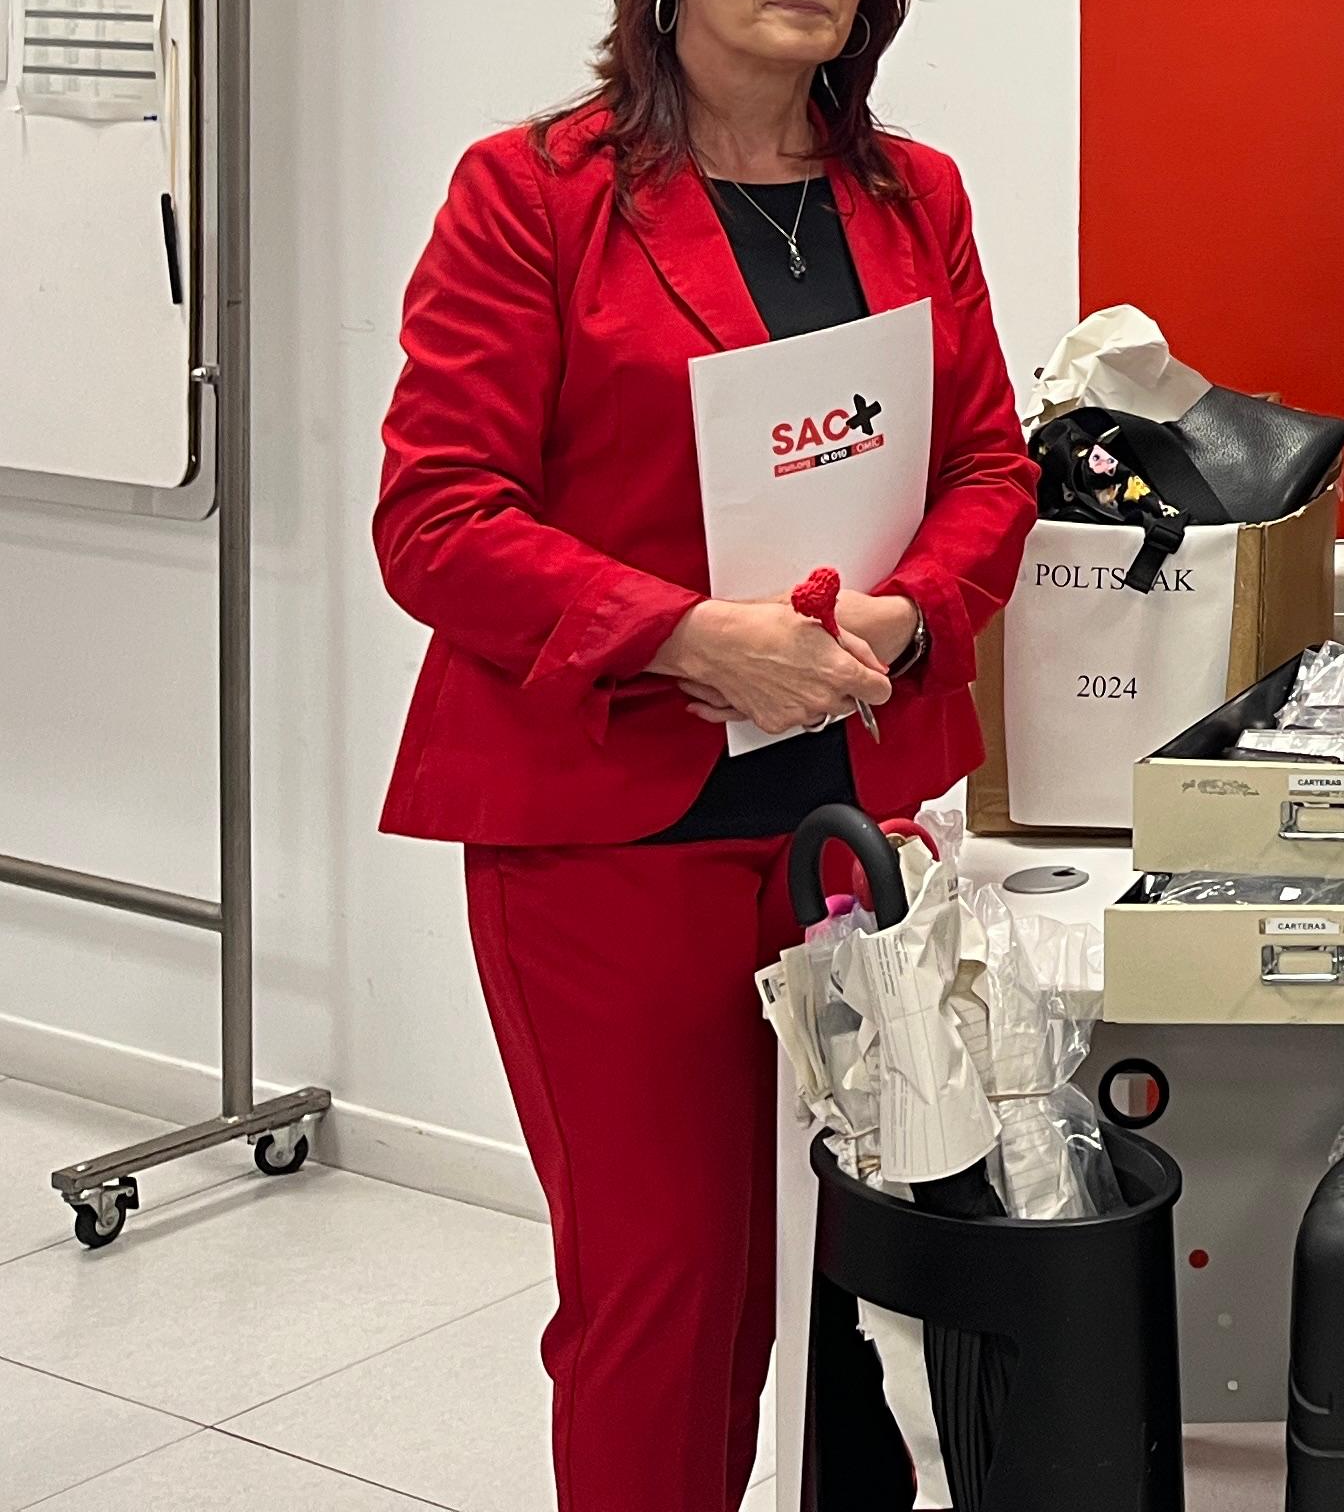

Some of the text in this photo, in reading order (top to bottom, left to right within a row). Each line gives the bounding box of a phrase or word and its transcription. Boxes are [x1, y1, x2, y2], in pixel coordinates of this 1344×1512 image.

[1034, 563, 1196, 593] POLTSAK
[1076, 675, 1138, 700] 2024
[1297, 778, 1343, 787] CARTERAS
[1277, 922, 1327, 931] CARTERAS
